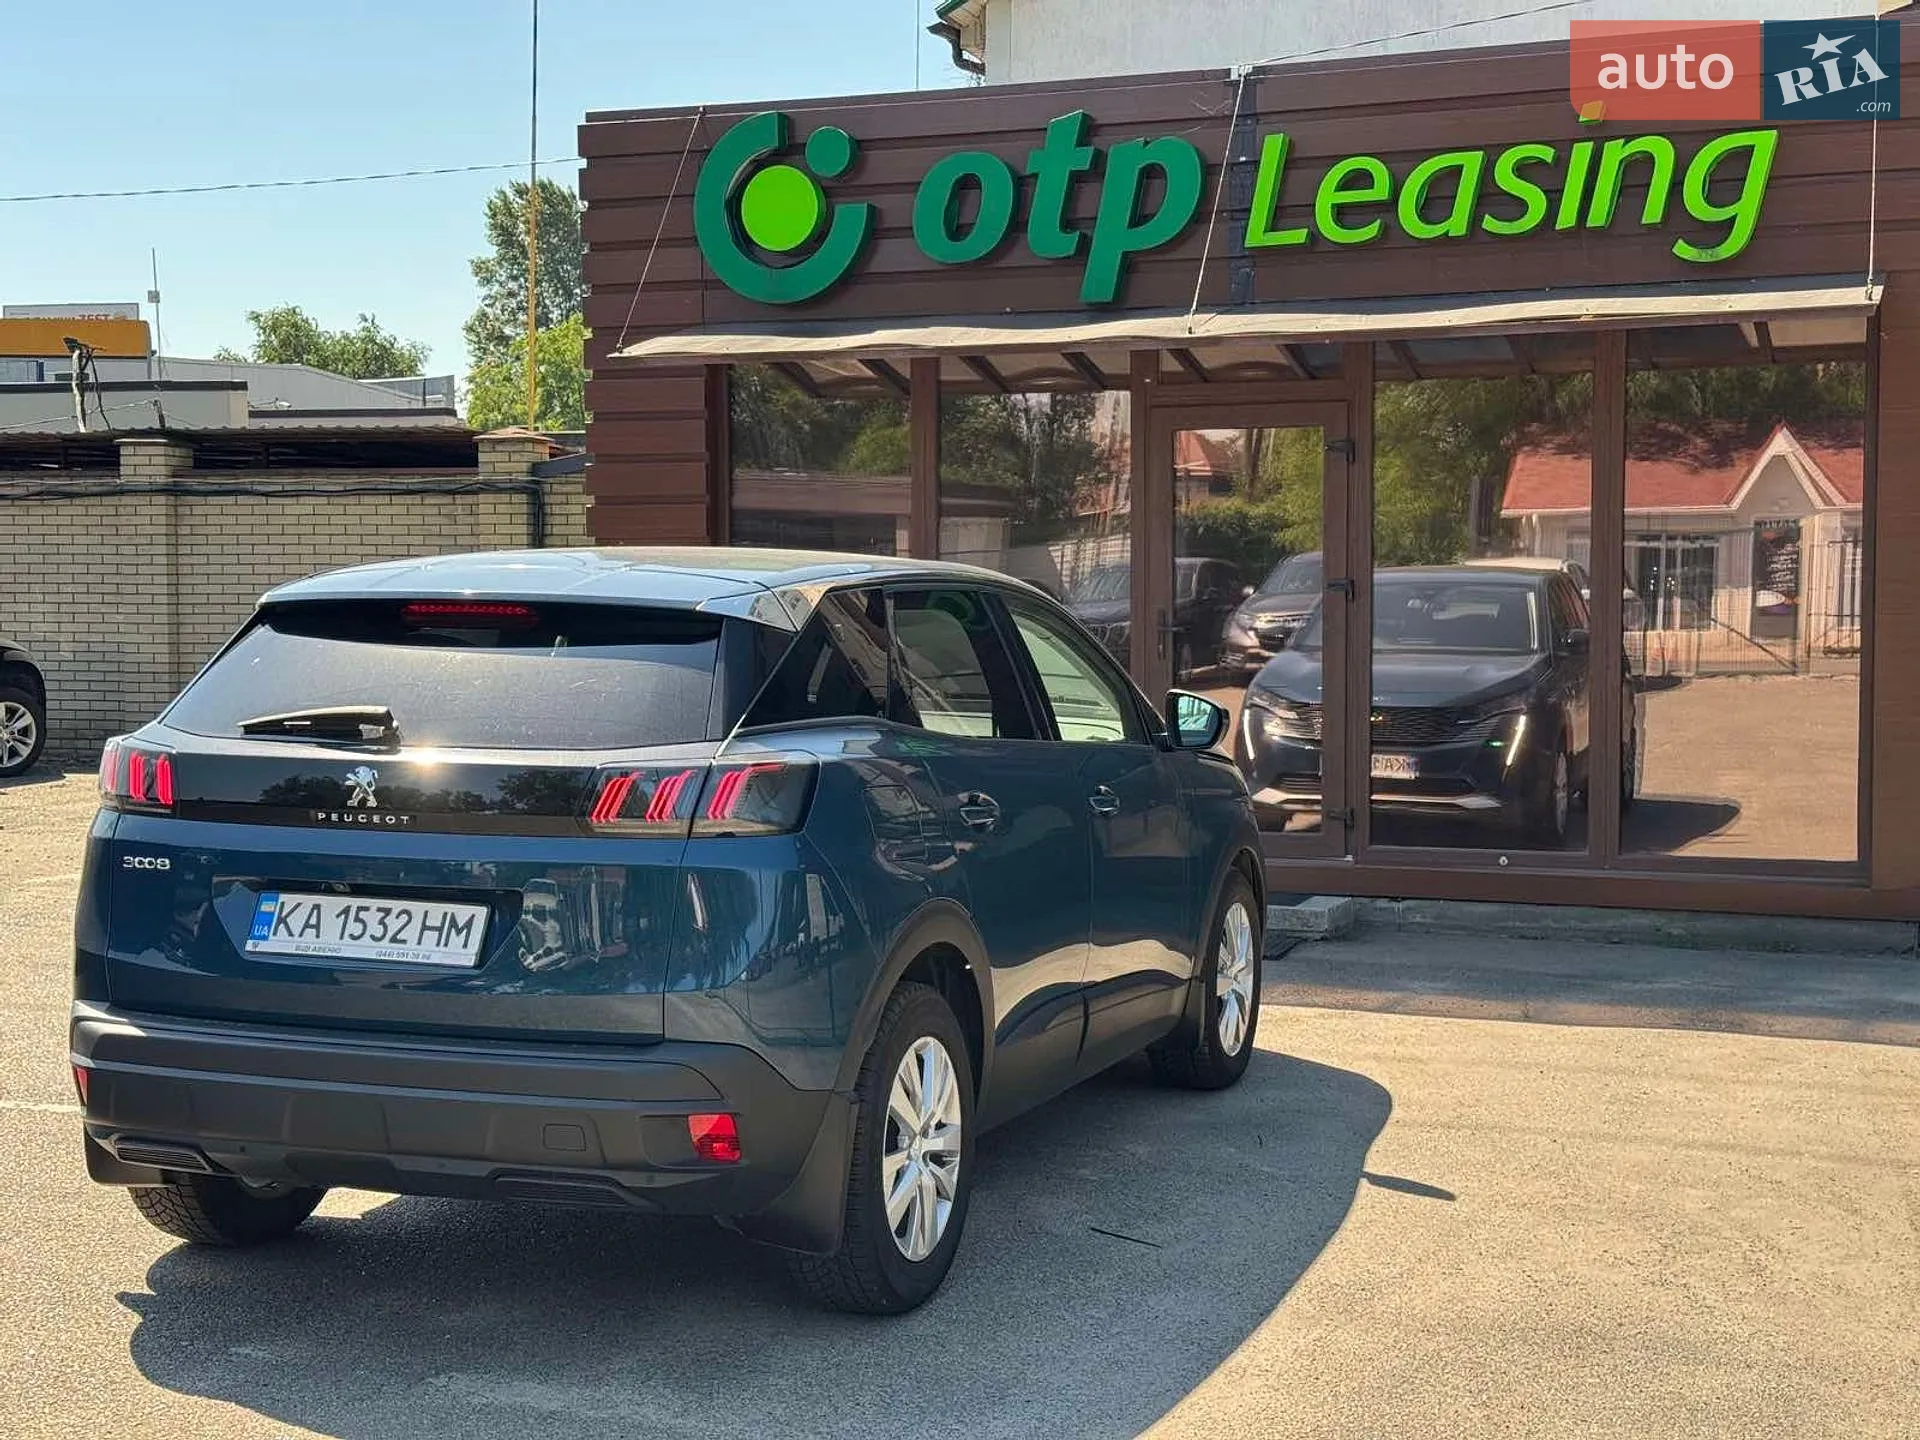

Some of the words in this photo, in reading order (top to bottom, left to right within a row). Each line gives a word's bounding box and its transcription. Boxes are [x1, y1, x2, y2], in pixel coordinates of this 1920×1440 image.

[912, 110, 1207, 303] otp
[1243, 100, 1778, 264] Leasing
[317, 812, 411, 825] PEUGEOT
[122, 856, 171, 870] 3008
[254, 925, 268, 936] UA
[272, 901, 321, 939] KA
[335, 904, 413, 944] 1532
[417, 910, 475, 949] HM
